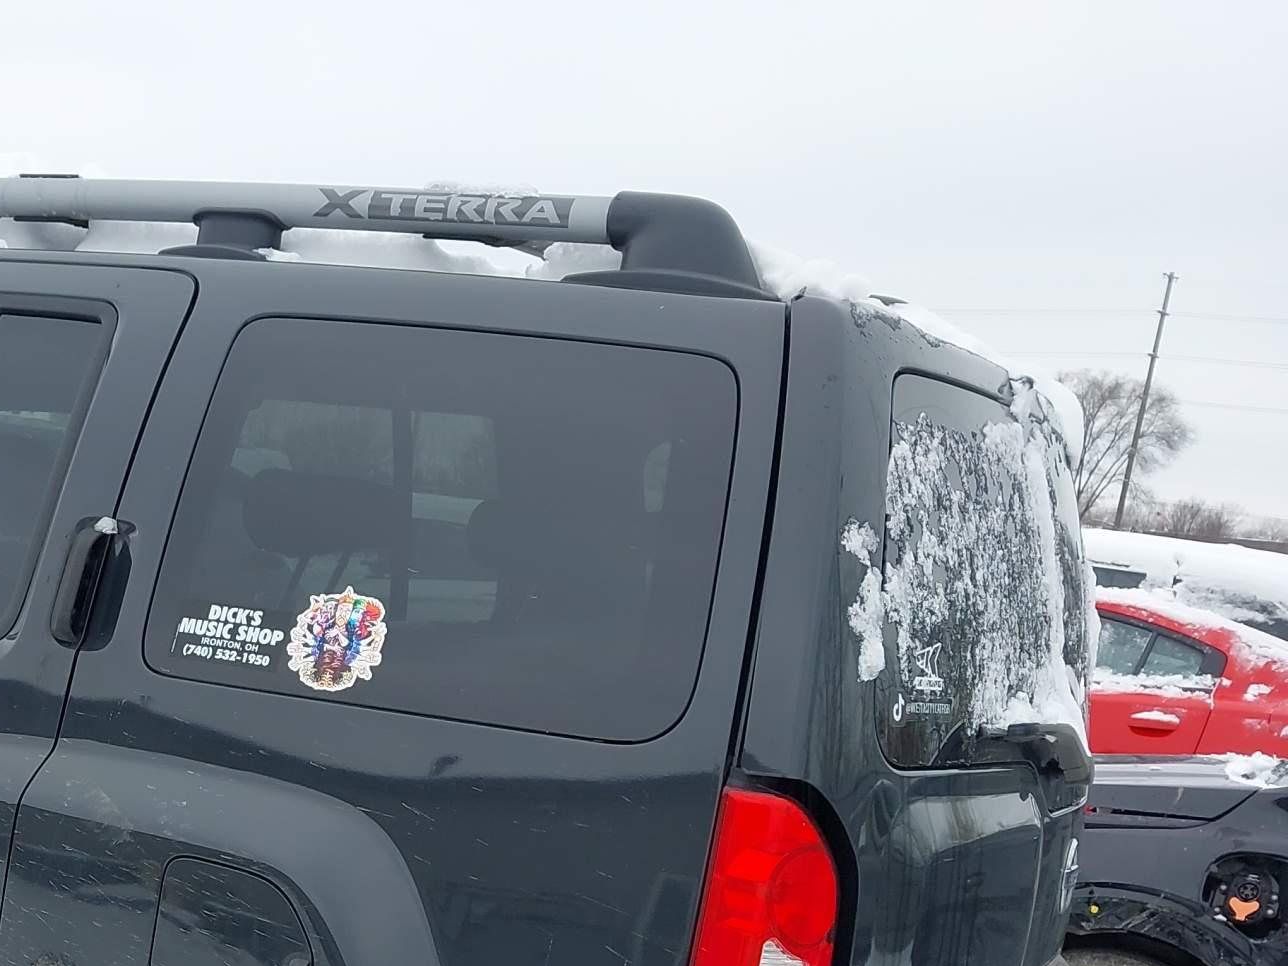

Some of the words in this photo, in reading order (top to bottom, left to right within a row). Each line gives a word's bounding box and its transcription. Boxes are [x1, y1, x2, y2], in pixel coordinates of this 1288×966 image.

[313, 187, 562, 227] XTERRA
[208, 604, 264, 625] DICK'S
[178, 617, 232, 640] MUSIC
[236, 626, 285, 647] SHOP
[182, 643, 213, 659] (740)
[215, 649, 271, 668] 532-1950
[201, 637, 243, 652] IRONTON,
[245, 643, 260, 654] OH
